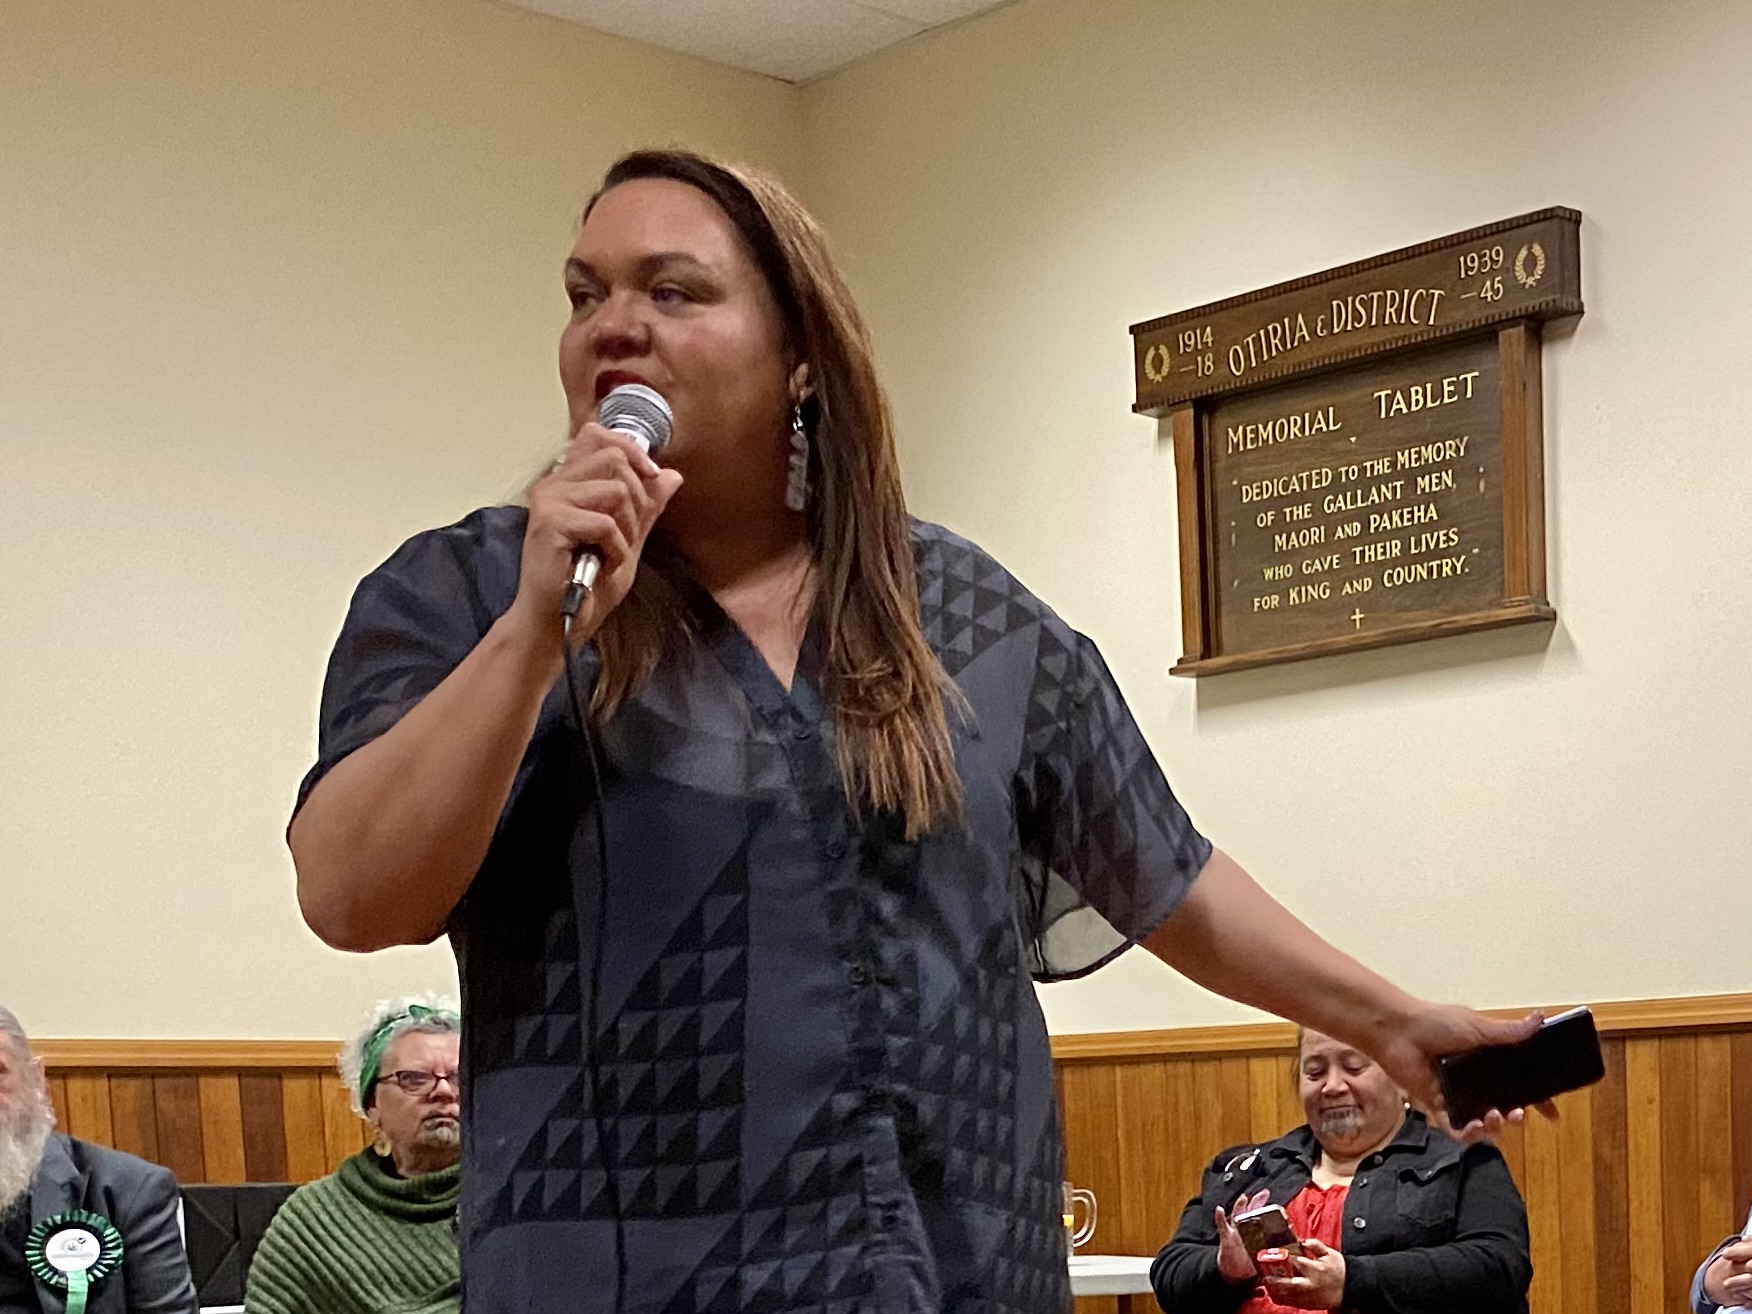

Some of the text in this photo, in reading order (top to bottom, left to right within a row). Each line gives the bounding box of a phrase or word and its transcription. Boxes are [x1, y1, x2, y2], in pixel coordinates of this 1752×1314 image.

[1459, 246, 1504, 279] 1939
[1178, 326, 1214, 354] 1914
[1228, 312, 1311, 376] OTIRIA
[1332, 288, 1445, 334] DISTRICT
[1227, 371, 1479, 454] MEMORIAL TABLET
[1339, 465, 1358, 482] TO
[1363, 458, 1391, 477] THE
[1397, 436, 1469, 470] MEMORY
[1256, 511, 1275, 527] OF
[1284, 503, 1312, 522] THE
[1324, 480, 1404, 514] GALLANT
[1275, 503, 1438, 552] MAORI AND PAKEHA
[1264, 528, 1459, 580] WHO GAVE THEIR LIVES
[1253, 595, 1279, 611] FOR
[1289, 582, 1330, 605] KING
[1341, 578, 1372, 595] AND
